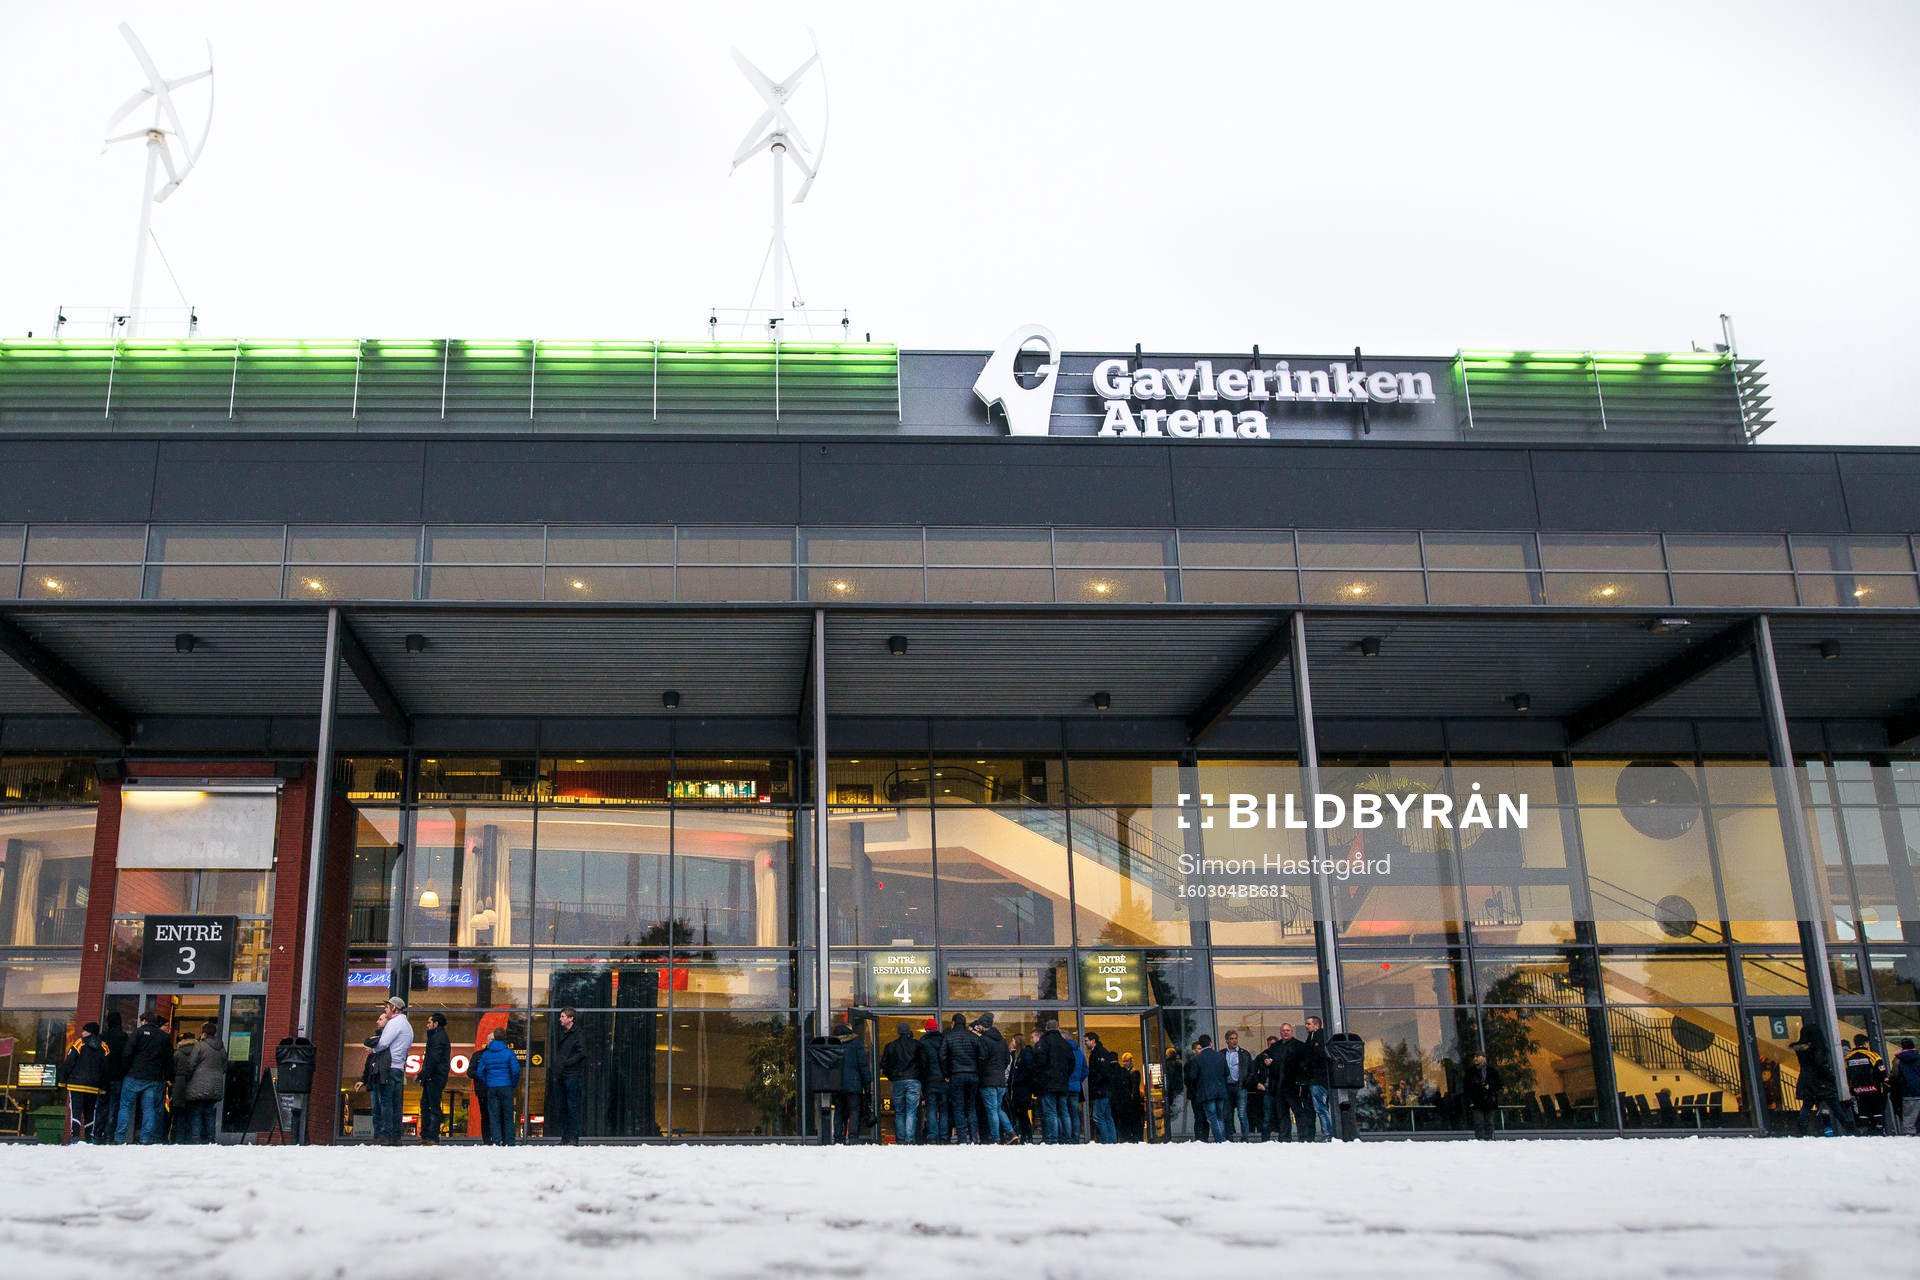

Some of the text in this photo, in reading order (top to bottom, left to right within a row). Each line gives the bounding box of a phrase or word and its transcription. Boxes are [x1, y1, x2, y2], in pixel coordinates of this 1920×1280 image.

[1092, 359, 1436, 403] Gavlerinken
[1098, 400, 1271, 439] Arena
[176, 946, 196, 975] 3
[872, 966, 931, 974] RESTAURANG
[1098, 966, 1127, 974] LOGER
[893, 978, 912, 1003] 4
[1105, 977, 1123, 1003] 5
[1773, 1020, 1785, 1035] 6
